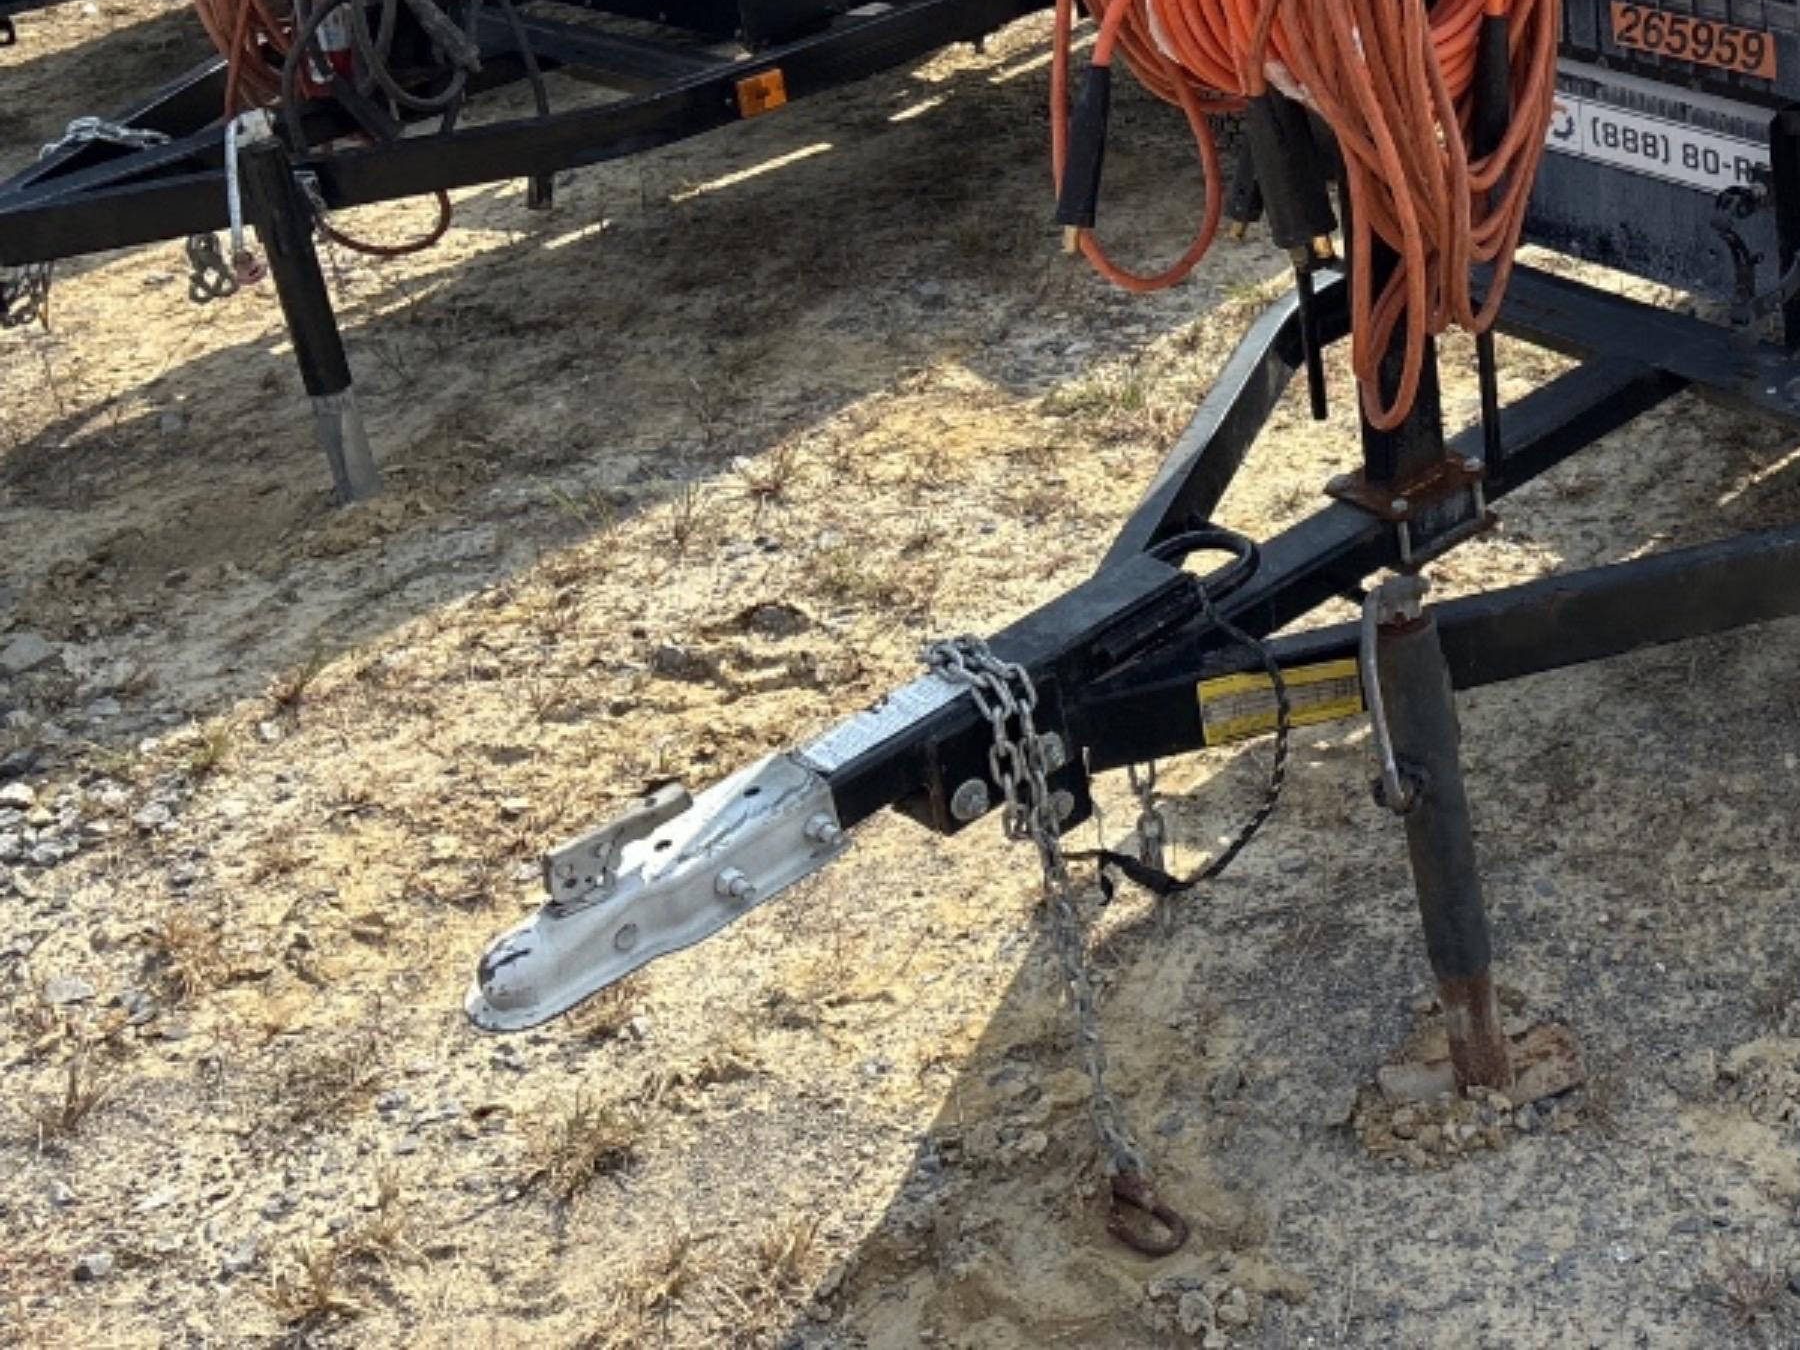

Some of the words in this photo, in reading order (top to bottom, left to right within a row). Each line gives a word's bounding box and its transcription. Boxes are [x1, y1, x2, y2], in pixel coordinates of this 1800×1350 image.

[1616, 5, 1767, 71] 265959
[1591, 115, 1671, 166] (888)
[1682, 143, 1762, 184] 80-R
